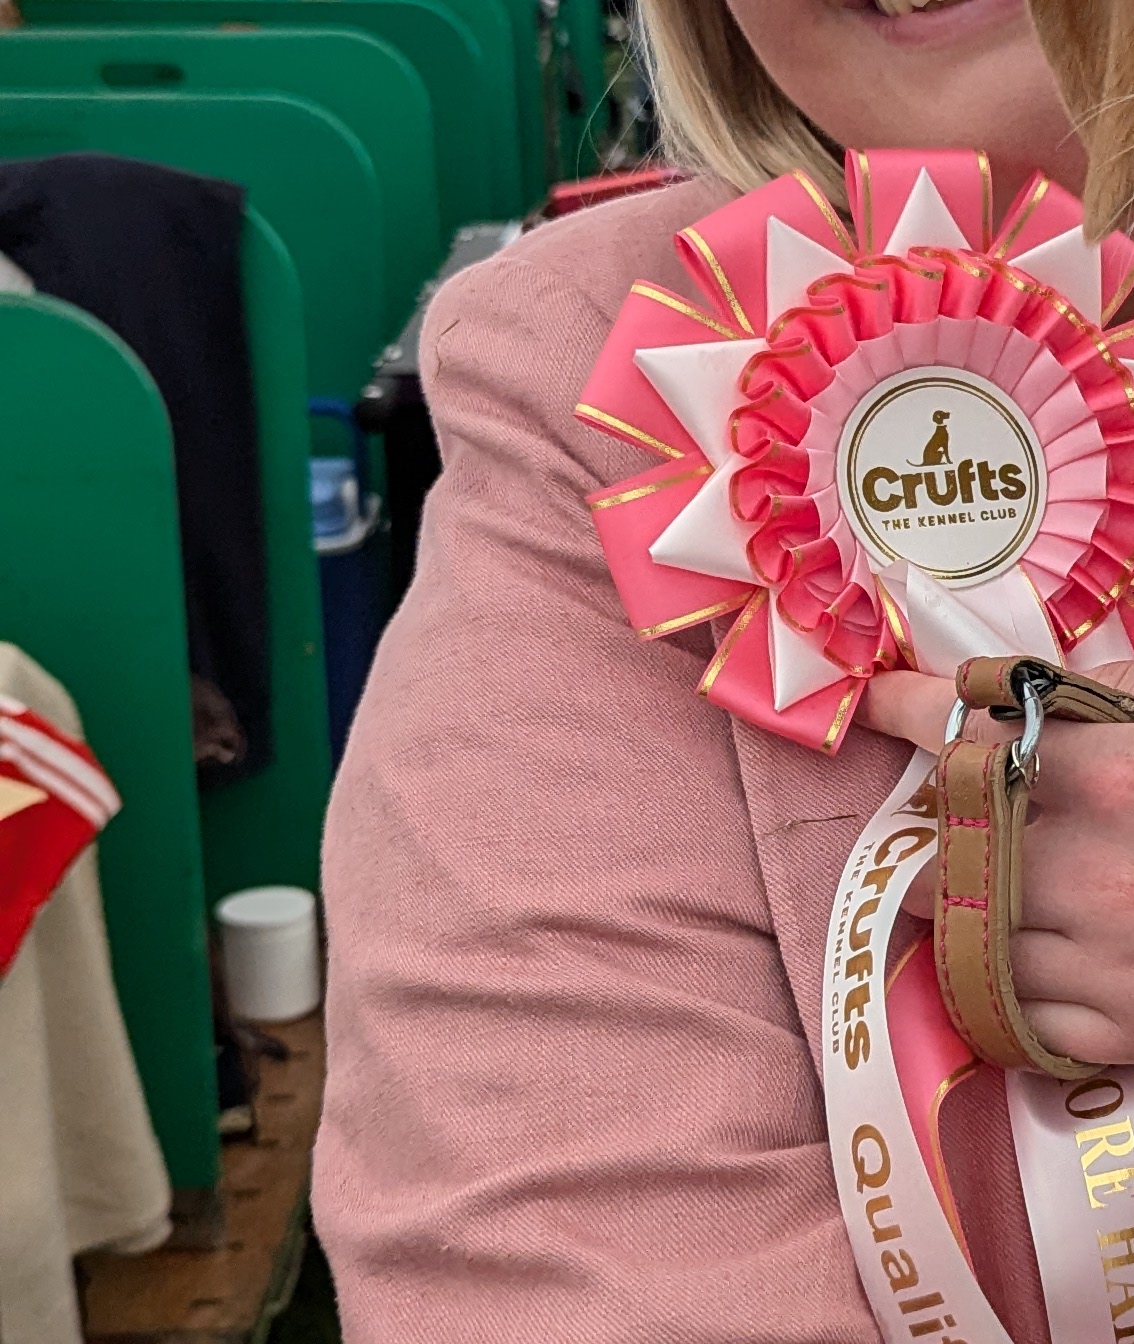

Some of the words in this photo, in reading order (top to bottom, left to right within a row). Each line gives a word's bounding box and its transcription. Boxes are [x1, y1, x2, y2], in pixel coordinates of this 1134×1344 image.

[862, 459, 1027, 513] Crufts
[881, 517, 911, 531] THE
[917, 511, 976, 528] KENNEL
[980, 507, 1017, 521] CLUB
[850, 840, 876, 881] THE
[831, 889, 855, 984] KENNEL
[843, 826, 938, 1071] Crufts
[831, 990, 840, 1055] CLUB
